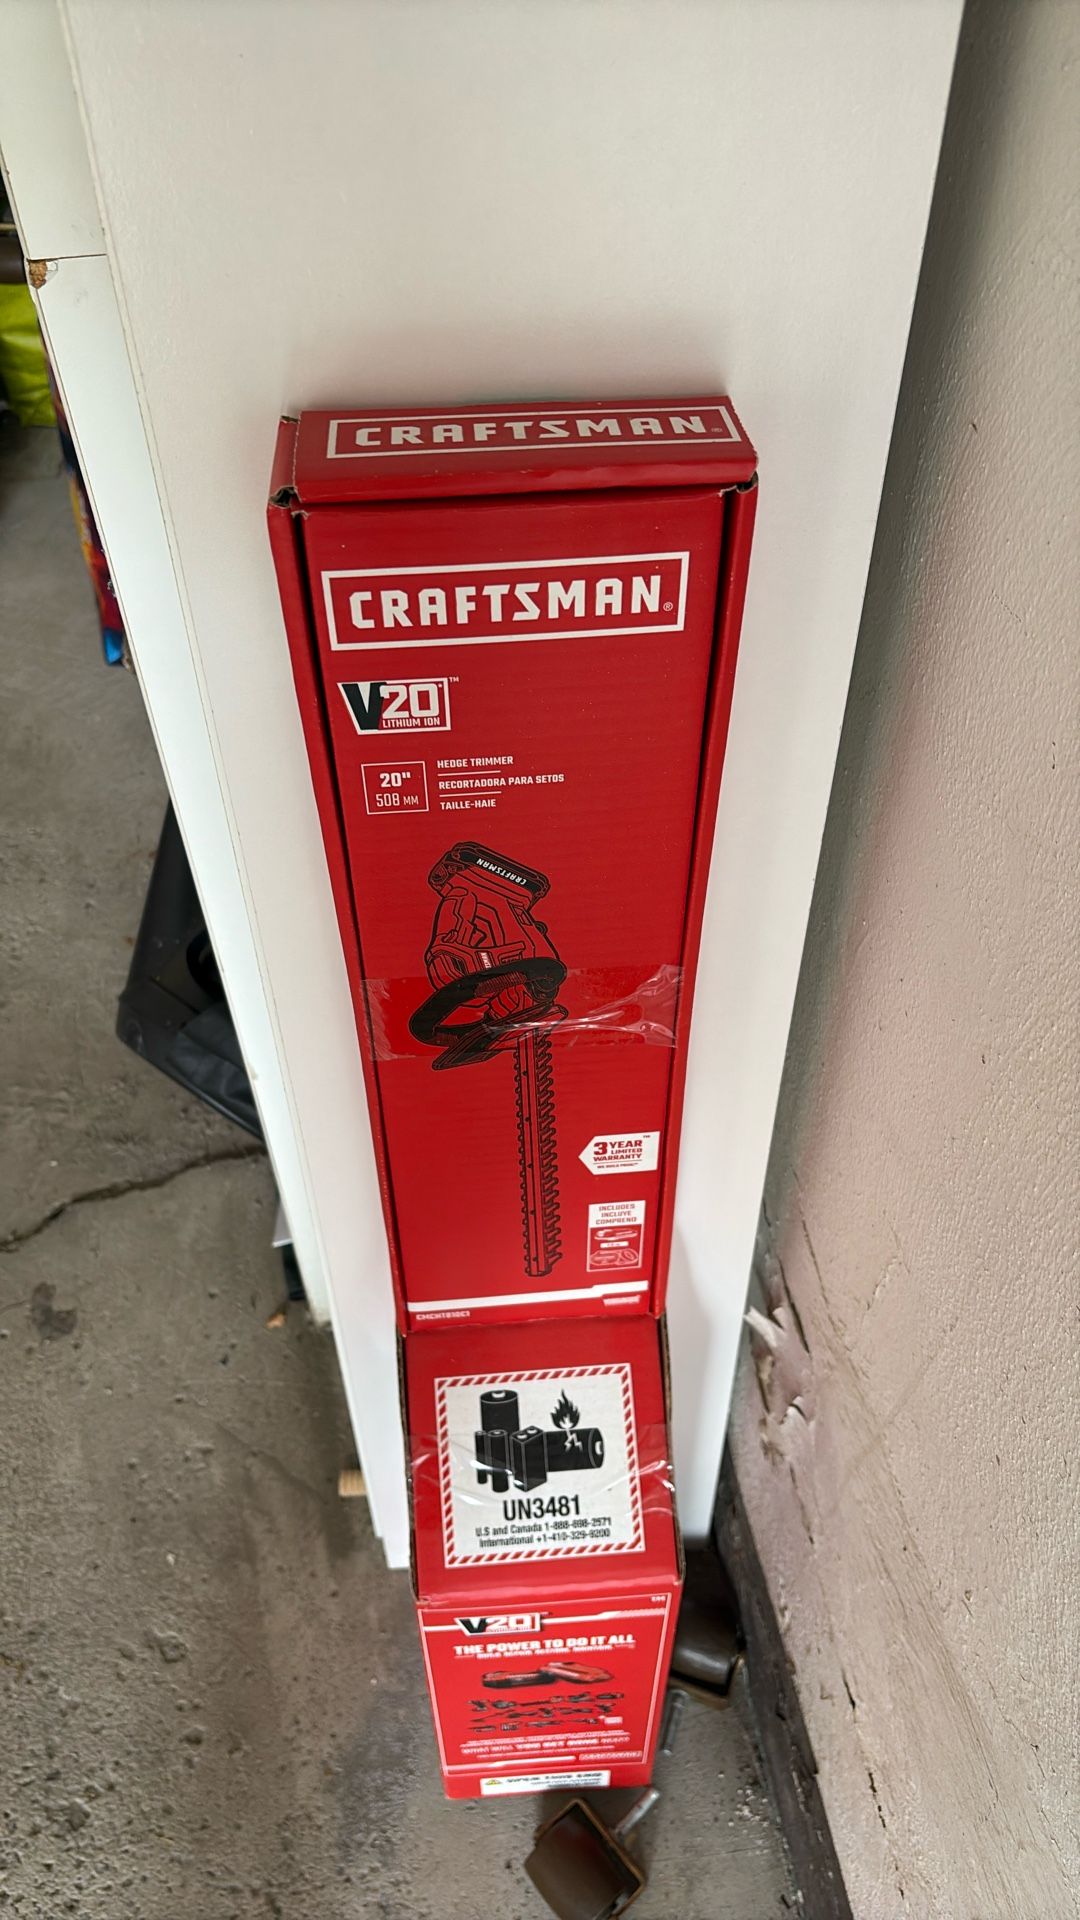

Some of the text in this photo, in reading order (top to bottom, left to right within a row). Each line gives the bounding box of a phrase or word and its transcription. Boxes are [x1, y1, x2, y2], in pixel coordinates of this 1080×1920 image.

[355, 416, 707, 447] CRAFTSMAN
[349, 575, 662, 629] CRAFTSMAN
[382, 717, 440, 729] LITHIUM ION
[437, 756, 514, 769] HEDGE TRIMMER
[379, 772, 411, 788] 20"
[438, 774, 565, 790] RECORTADORA PARA SETOS
[375, 793, 419, 807] 508 MM
[440, 799, 496, 810] TAILLE-HAIE
[476, 858, 527, 885] CRAFTSMAN
[593, 1140, 643, 1155] 3 YEAR
[593, 1153, 642, 1162] WARRANTY
[598, 1203, 636, 1212] INCLUDES
[503, 1494, 580, 1521] UN3481
[475, 1526, 490, 1537] U.S
[492, 1524, 508, 1536] and
[510, 1521, 542, 1534] Canada
[479, 1535, 534, 1548] International
[454, 1644, 484, 1656] THE
[486, 1640, 541, 1654] POWER
[543, 1638, 564, 1649] TO
[566, 1636, 588, 1648] DO
[590, 1635, 606, 1646] IT
[608, 1633, 636, 1645] ALL
